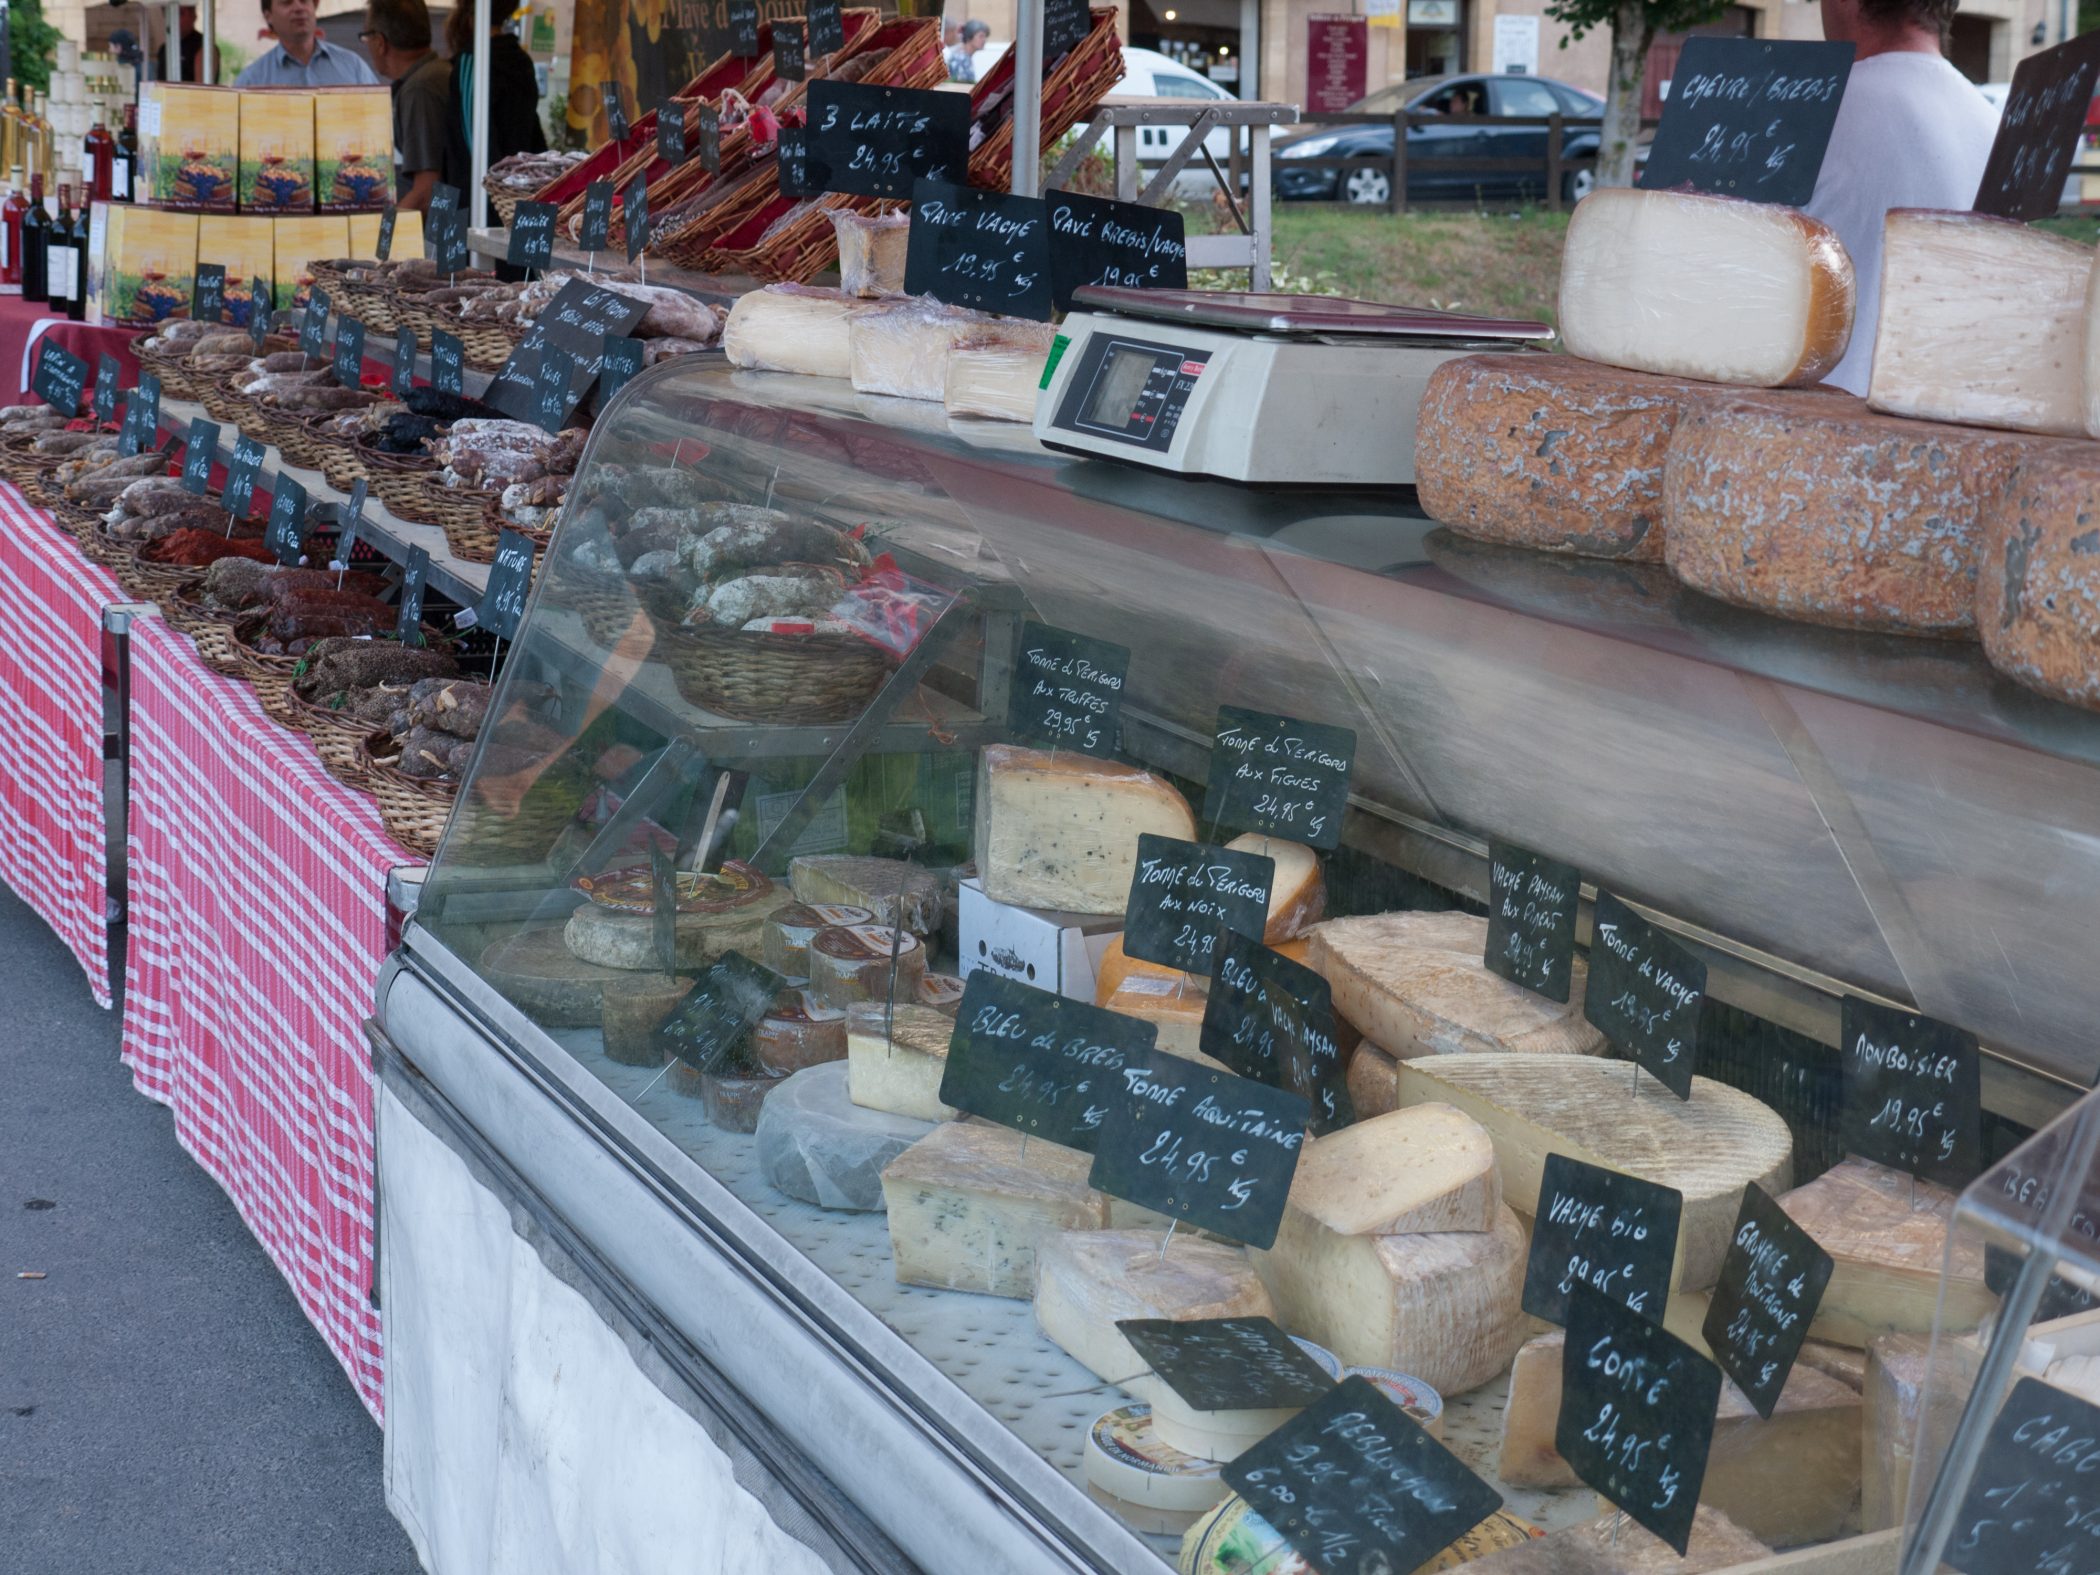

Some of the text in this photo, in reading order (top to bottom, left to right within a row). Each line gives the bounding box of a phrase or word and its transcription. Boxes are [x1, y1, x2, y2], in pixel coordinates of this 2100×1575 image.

[820, 104, 932, 134] 3 LAITS
[849, 144, 947, 181] 24,95 € K
[976, 211, 1038, 245] VACHE
[1053, 205, 1097, 237] PAVÉ
[942, 251, 1038, 297] 19,95 € Kg
[1090, 264, 1160, 287] 1995 €
[496, 548, 528, 573] NATURE
[1059, 687, 1109, 714] TRUFFES
[1043, 709, 1101, 748] 29,95 € Kg
[1270, 767, 1321, 792] FIGUES
[1253, 794, 1326, 838] 24,95 € Kg
[1492, 860, 1565, 905] VACHE PAYSAN
[1187, 900, 1227, 921] NOIX
[1220, 957, 1258, 994] BLEU
[1655, 968, 1700, 1010] VACHE
[971, 1005, 1027, 1040] BLEU
[1061, 1038, 1127, 1071] BREB
[1192, 1094, 1305, 1151] AQUITAINE
[1869, 1098, 1930, 1139] 19,95
[1937, 1128, 1956, 1161] Kg
[1139, 1130, 1260, 1210] 24,95 € Kg
[1548, 1191, 1605, 1240] VACHE
[1587, 1335, 1682, 1406] COMTÉ
[1320, 1412, 1458, 1514] REBLOCHON
[1583, 1403, 1680, 1509] 24,95 € Kg
[1245, 1467, 1297, 1504] 6,00
[1319, 1530, 1361, 1567] 1/2
